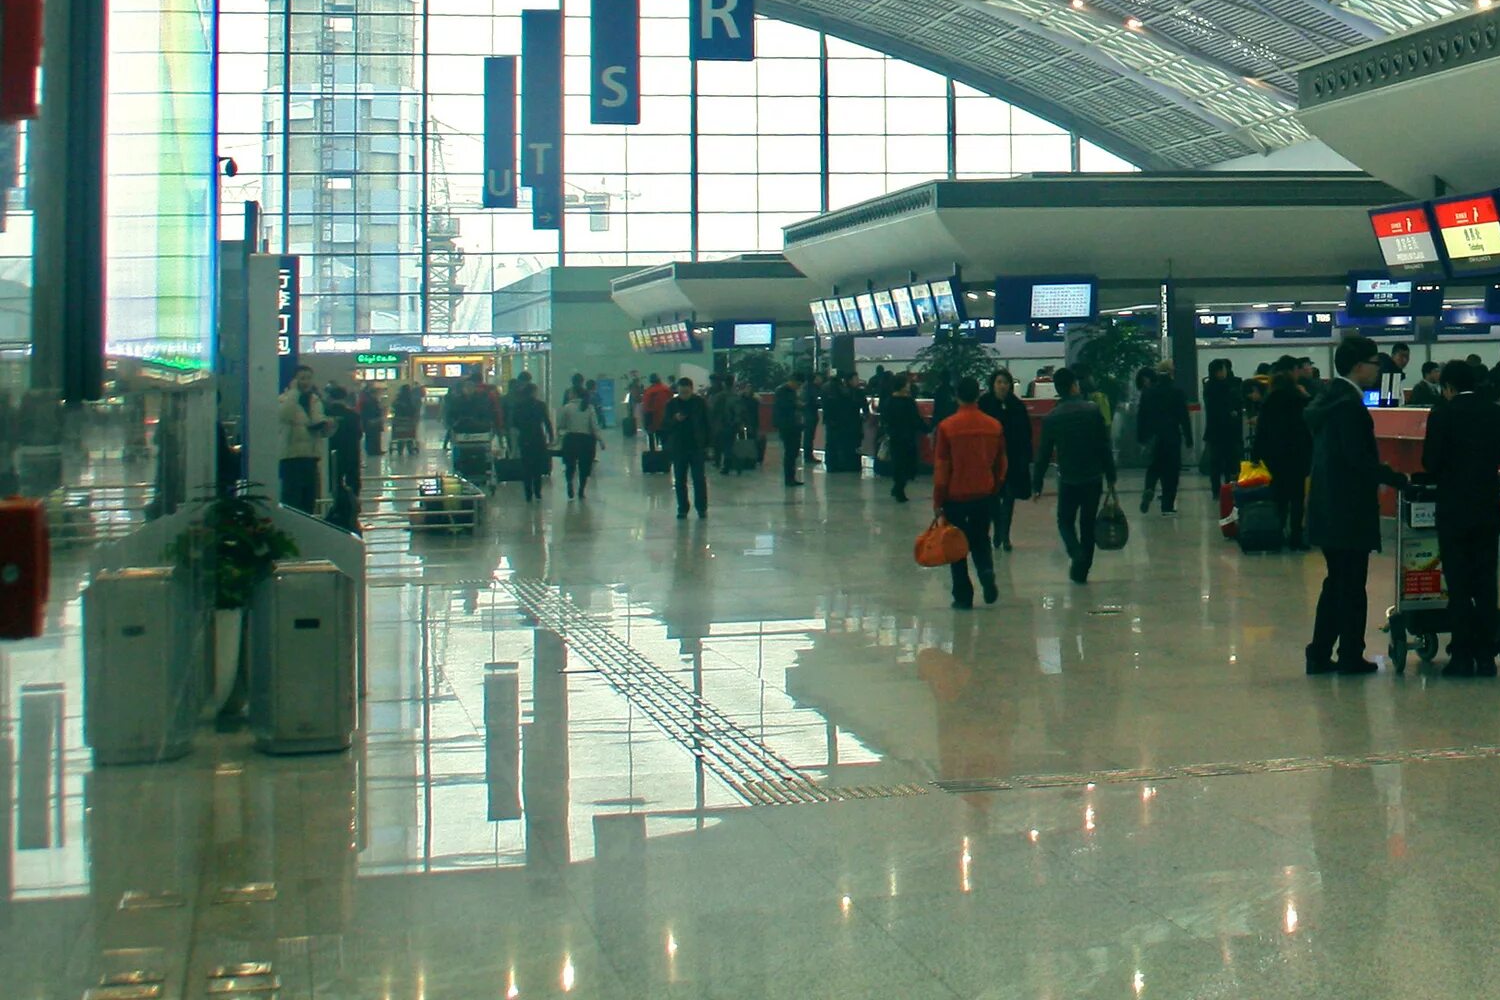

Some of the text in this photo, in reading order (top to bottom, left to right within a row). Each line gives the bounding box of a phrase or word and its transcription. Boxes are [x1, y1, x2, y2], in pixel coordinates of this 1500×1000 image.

[601, 66, 628, 108] S
[529, 143, 552, 176] T
[488, 169, 511, 197] U
